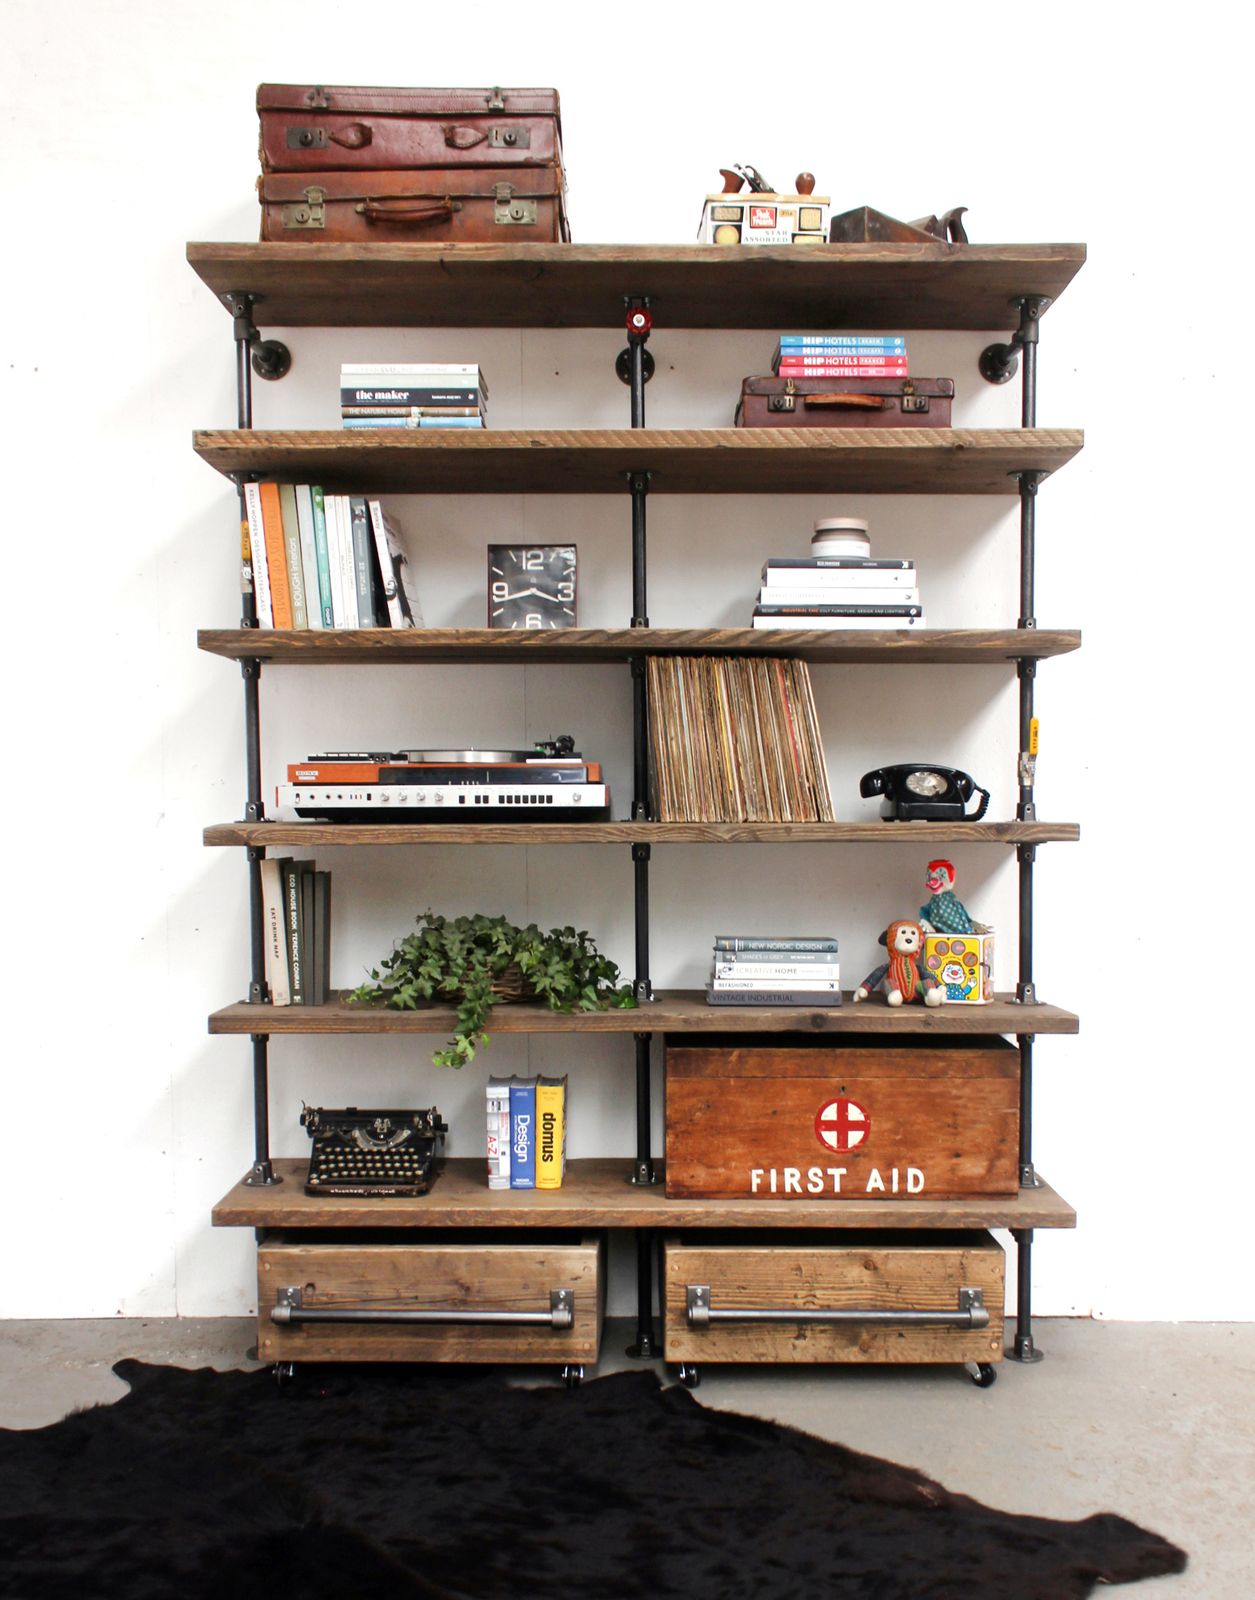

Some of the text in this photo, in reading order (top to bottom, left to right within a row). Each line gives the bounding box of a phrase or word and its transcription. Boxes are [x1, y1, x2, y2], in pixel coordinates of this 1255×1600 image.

[802, 336, 823, 344] HIP
[824, 336, 856, 344] HOTELS
[802, 346, 823, 354] HIP
[824, 346, 856, 354] HOTELS
[803, 356, 824, 364] HIP
[825, 356, 858, 364] HOTELS
[803, 368, 825, 376] HIP
[826, 368, 858, 376] HOTELS
[355, 390, 373, 400] the
[375, 390, 409, 400] maker
[251, 509, 259, 537] HOPPEN
[372, 507, 381, 529] Banksy
[253, 539, 261, 564] DESIGN
[269, 536, 281, 557] JOY
[289, 538, 299, 572] interiors
[271, 559, 282, 576] OF
[522, 550, 544, 571] 12
[256, 565, 266, 613] MASTERCLASS
[273, 578, 287, 615] HOME
[292, 573, 303, 607] ROUGH
[492, 582, 509, 602] 9
[557, 582, 575, 601] 3
[525, 613, 542, 629] 6
[290, 911, 298, 930] BOOK
[749, 942, 765, 950] NEW
[712, 994, 794, 1002] VINTAGE INDUSTRIAL
[487, 1135, 497, 1155] A-Z
[514, 1114, 530, 1163] Design
[542, 1112, 556, 1162] domus
[751, 1167, 925, 1193] FIRST AID
